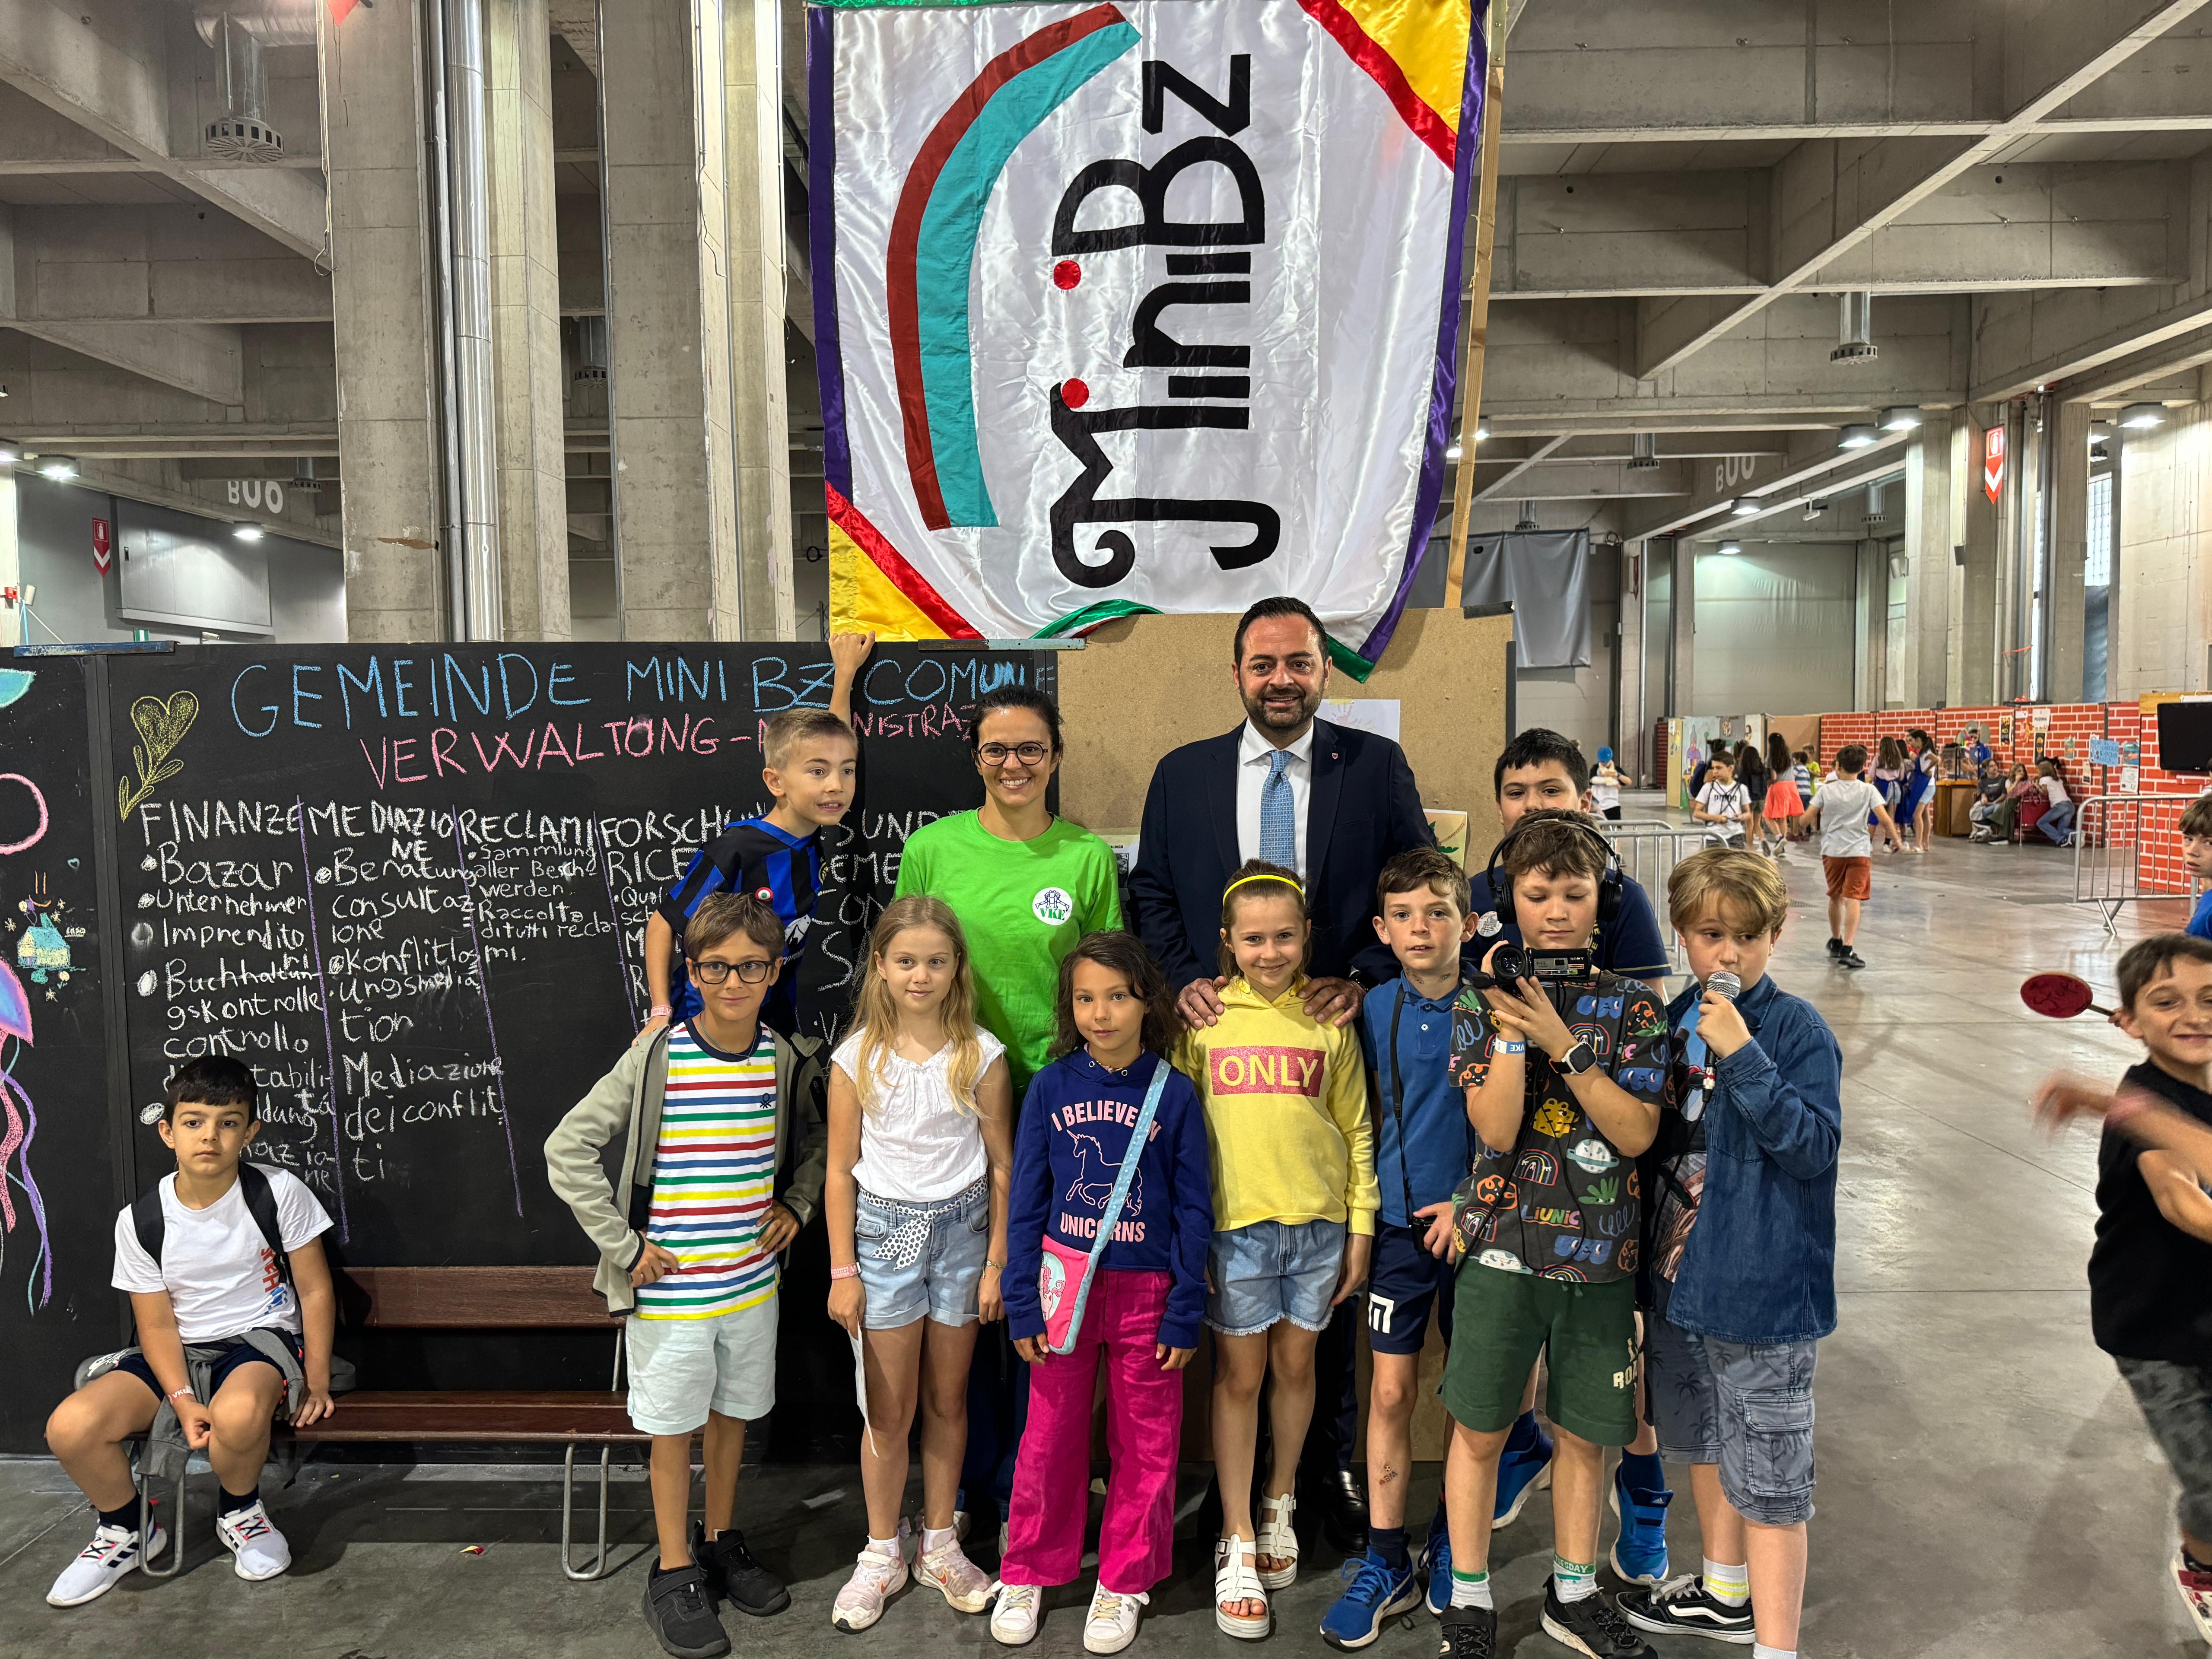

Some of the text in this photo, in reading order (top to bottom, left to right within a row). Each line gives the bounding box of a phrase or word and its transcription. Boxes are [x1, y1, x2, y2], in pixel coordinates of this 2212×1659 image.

[231, 653, 591, 737] GEMEINDE
[626, 656, 728, 703] MINI
[140, 800, 304, 847] FINANZE
[458, 809, 594, 849] RECLAMI
[157, 840, 294, 891] Bazar
[474, 859, 520, 879] aller
[480, 840, 597, 873] Sammlung
[478, 898, 584, 923] Raccolta
[1040, 908, 1065, 921] VKE
[163, 1020, 309, 1058] controllo
[1219, 1055, 1319, 1088] ONLY
[1051, 1112, 1062, 1131] I
[1062, 1100, 1138, 1128] BELIEVE
[1555, 1554, 1588, 1573] TUESDAY
